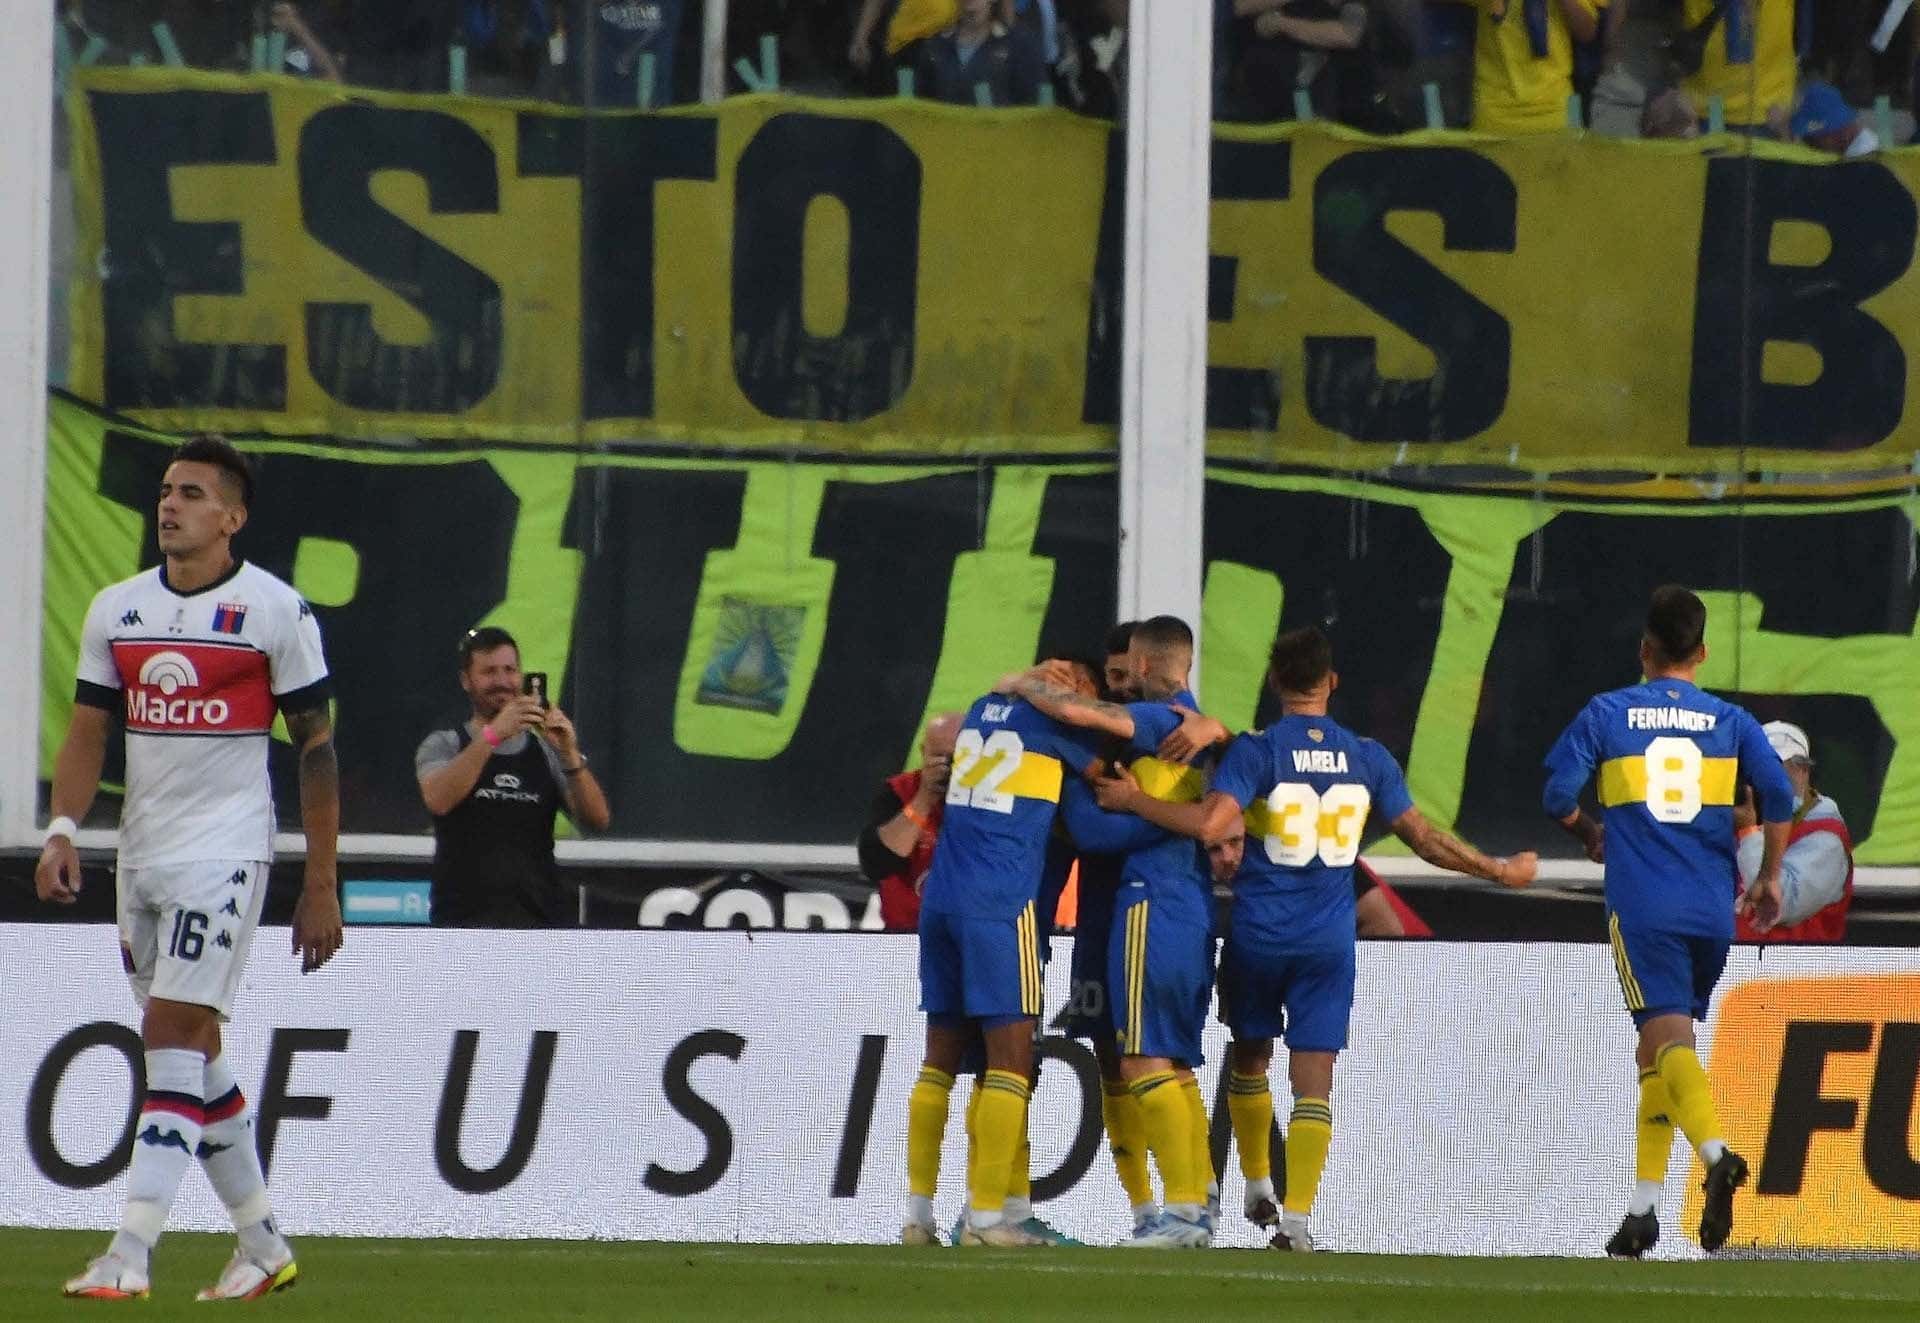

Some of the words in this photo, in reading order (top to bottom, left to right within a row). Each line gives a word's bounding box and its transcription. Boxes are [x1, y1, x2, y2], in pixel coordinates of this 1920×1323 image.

[87, 90, 922, 424] ESTO
[1082, 127, 1517, 443] ES
[1689, 156, 1918, 451] B
[127, 688, 229, 725] Macro
[1627, 707, 1717, 731] FERNANDEZ
[945, 728, 1025, 815] 22
[1292, 750, 1349, 773] VARELA
[1645, 736, 1703, 824] 8
[1264, 782, 1371, 868] 33
[169, 909, 209, 961] 16
